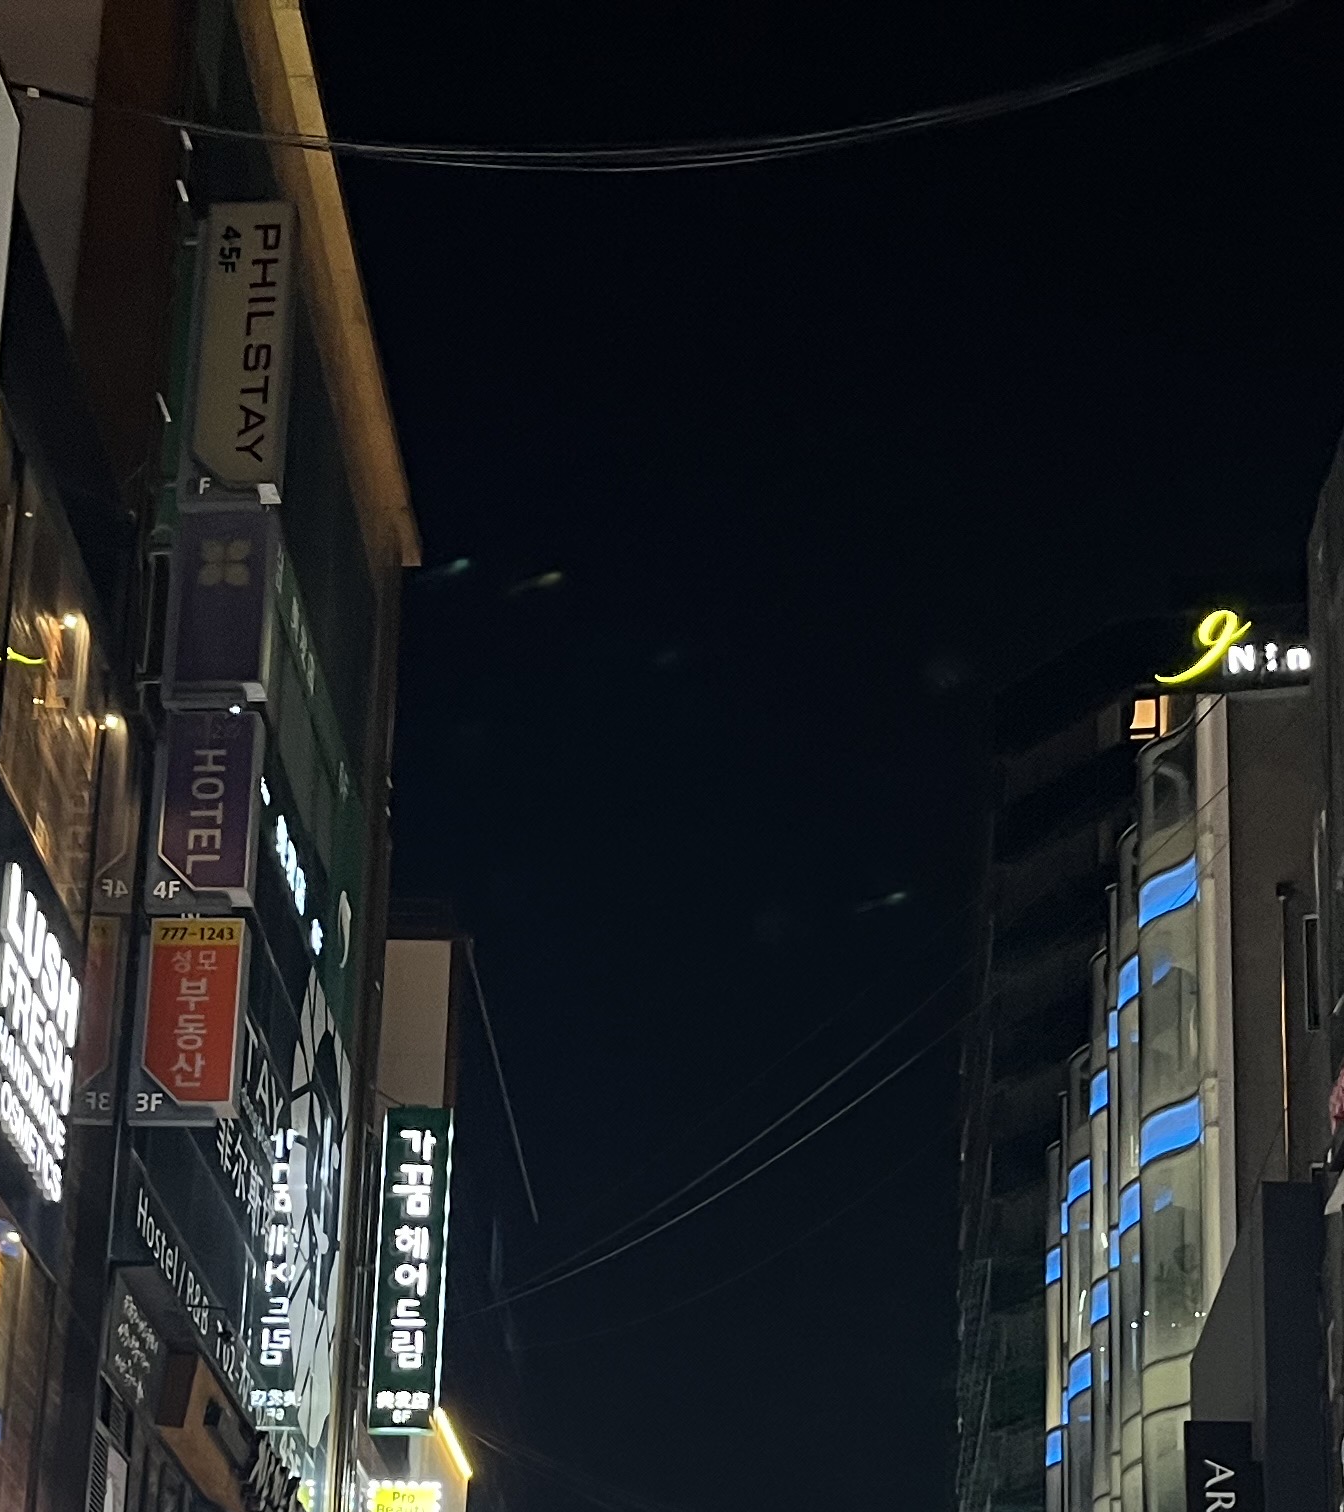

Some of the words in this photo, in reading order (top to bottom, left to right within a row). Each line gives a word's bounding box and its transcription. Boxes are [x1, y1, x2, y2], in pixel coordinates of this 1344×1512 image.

[235, 223, 283, 463] PHILSTAY
[185, 748, 228, 875] HOTEL
[153, 880, 181, 899] 4F
[1, 861, 81, 1049] LUSH
[160, 926, 235, 942] 777-1243
[170, 950, 218, 971] 성모
[169, 977, 209, 1088] 부동산
[135, 1093, 164, 1112] 3F
[136, 1186, 179, 1290] Hostel
[392, 1491, 416, 1504] Pro
